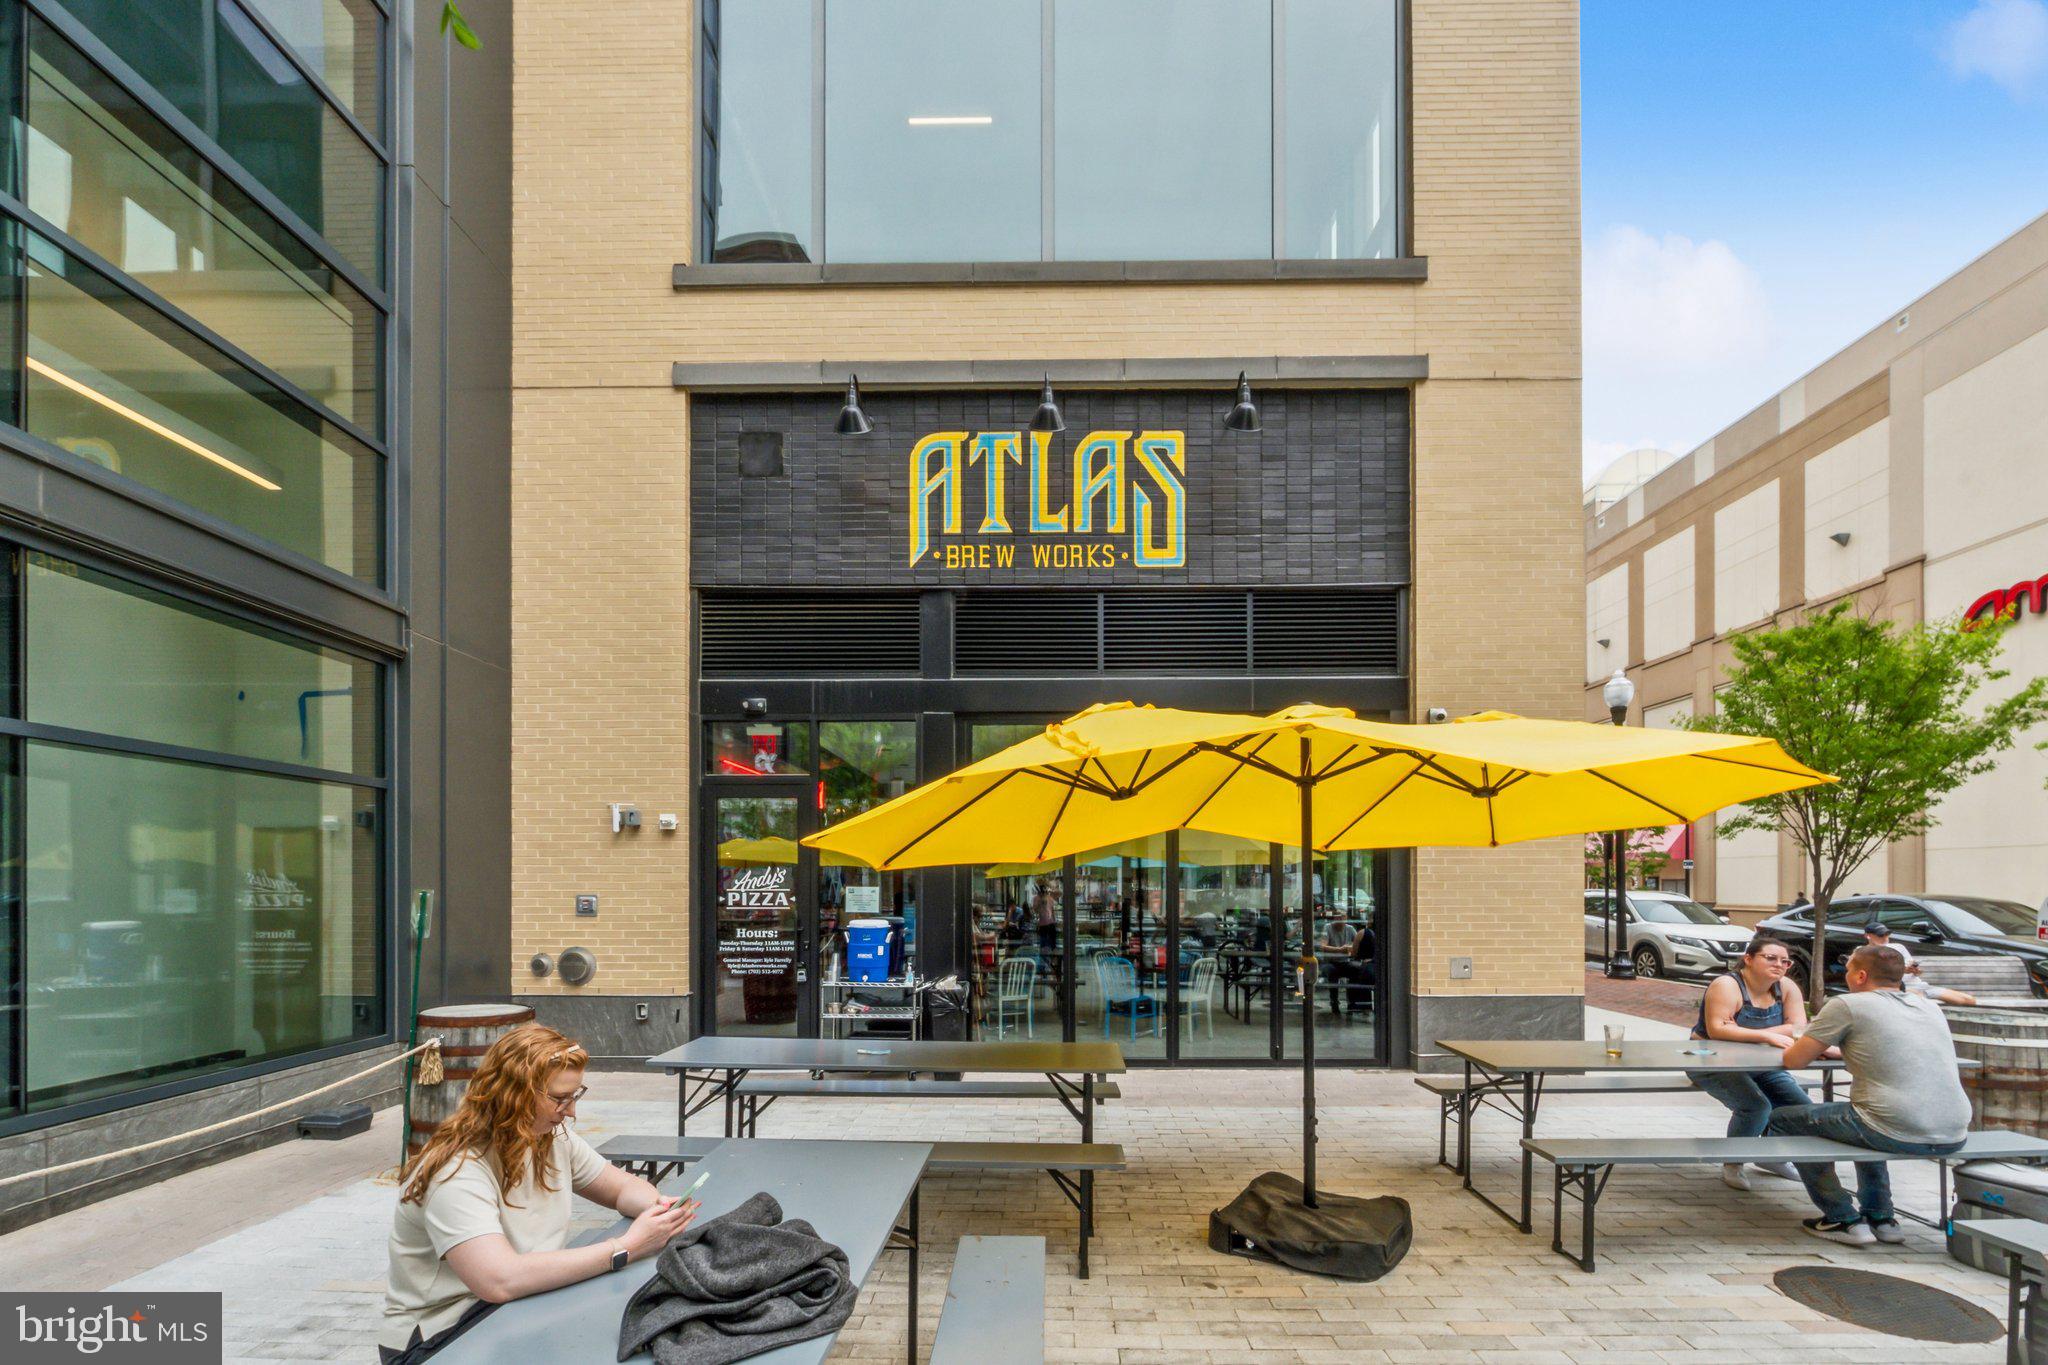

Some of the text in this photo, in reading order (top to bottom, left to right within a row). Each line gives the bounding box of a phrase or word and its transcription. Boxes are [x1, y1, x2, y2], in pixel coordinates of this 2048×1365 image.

[909, 430, 1186, 569] ATLAS
[945, 544, 1116, 569] BREW WORKS
[733, 866, 787, 892] Andy's
[728, 892, 789, 906] PIZZA
[736, 928, 779, 938] Hours:
